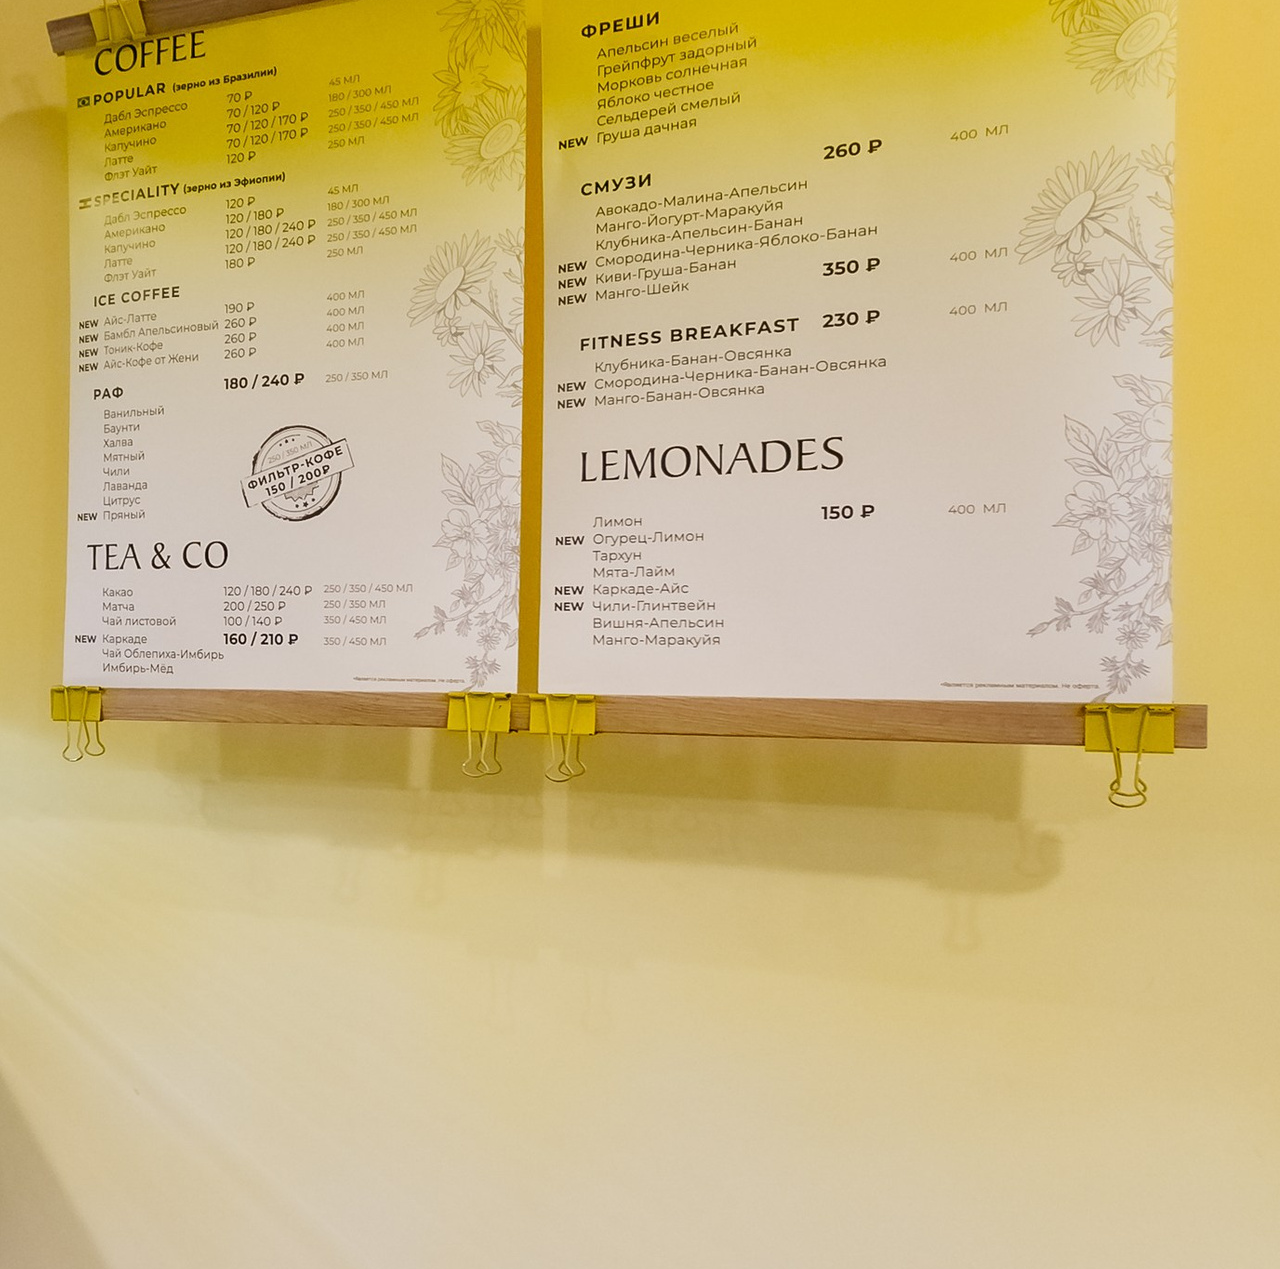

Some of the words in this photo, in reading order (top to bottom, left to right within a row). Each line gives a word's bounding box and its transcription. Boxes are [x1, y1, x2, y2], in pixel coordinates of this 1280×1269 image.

[581, 11, 659, 38] ФРЕШИ
[596, 37, 668, 60] Апельсин
[673, 21, 738, 44] веселый
[94, 30, 206, 76] COFFEE
[597, 52, 676, 78] Грейпфрут
[679, 36, 756, 60] задорный
[597, 74, 662, 93] Морковь
[665, 57, 747, 80] солнечная
[93, 82, 166, 106] POPULAR
[172, 80, 206, 93] (зерно
[208, 77, 220, 86] из
[223, 65, 277, 84] Бразилии)
[597, 92, 650, 110] Яблоко
[653, 80, 714, 98] честное
[103, 109, 131, 125] Дабл
[133, 102, 188, 118] Эспрессо
[596, 101, 676, 126] Сельдерей
[680, 91, 740, 112] смелый
[103, 120, 166, 138] Американо
[558, 135, 588, 150] NEW
[596, 127, 640, 145] Груша
[643, 118, 696, 137] дачная
[104, 136, 156, 152] Капучино
[823, 141, 860, 159] 260
[103, 154, 133, 167] Латте
[104, 169, 130, 181] Флэт
[131, 164, 157, 177] Уайт
[94, 183, 180, 207] SPECIALITY
[183, 182, 217, 194] (зерно
[219, 180, 231, 188] из
[234, 171, 285, 187] Эфиопии)
[580, 173, 651, 196] СМУЗИ
[595, 180, 807, 217] Авокадо-Малина-Апельсин
[596, 199, 783, 234] Манго-Йогурт-Маракуйя
[104, 223, 165, 239] Американо
[595, 216, 802, 251] Клубника-Апельсин-Банан
[104, 239, 156, 254] Капучино
[558, 260, 587, 274] NEW
[595, 225, 877, 267] Смородина-Черника-Яблоко-Банан
[103, 257, 132, 268] Латте
[822, 259, 859, 276] 350
[558, 276, 587, 289] NEW
[595, 259, 736, 284] Киви-Груша-Банан
[93, 293, 115, 307] ICE
[120, 285, 179, 303] COFFEE
[558, 292, 587, 306] NEW
[595, 280, 689, 301] Манго-Шейк
[224, 302, 243, 314] 190
[78, 319, 98, 329] NEW
[103, 312, 157, 326] Айс-Латте
[78, 333, 98, 344] NEW
[103, 327, 135, 341] Бамбл
[137, 319, 218, 337] Апельсиновый
[580, 330, 661, 351] FITNESS
[670, 317, 799, 342] BREAKFAST
[822, 311, 858, 328] 230
[78, 347, 98, 358] NEW
[103, 339, 163, 354] Тоник-Кофе
[78, 362, 98, 372] NEW
[103, 356, 152, 369] Айс-Кофе
[154, 356, 166, 364] от
[167, 352, 198, 364] Жени
[594, 347, 791, 374] Клубника-Банан-Овсянка
[223, 376, 248, 389] 180
[261, 373, 289, 387] 240
[557, 380, 586, 392] NEW
[594, 357, 886, 389] Смородина-Черника-Банан-Овсянка
[93, 386, 123, 400] РАФ
[557, 397, 586, 409] NEW
[594, 385, 764, 406] Манго-Банан-Овсянка
[103, 404, 164, 419] Ванильный
[103, 423, 140, 435] Баунти
[102, 438, 133, 448] Халва
[103, 450, 144, 462] Мятный
[580, 436, 843, 482] LEMONADES
[102, 467, 130, 476] Чили
[248, 446, 343, 489] ФИЛЬТР-КОФЕ
[102, 481, 147, 491] Лаванда
[266, 482, 286, 496] 150
[102, 496, 140, 507] Цитрус
[77, 512, 97, 521] NEW
[102, 508, 145, 522] Пряный
[820, 505, 853, 519] 150
[592, 516, 642, 528] Лимон
[555, 535, 584, 545] NEW
[592, 531, 704, 546] Огурец-Лимон
[86, 543, 141, 570] TEA
[151, 542, 170, 569] &
[182, 540, 228, 568] CO
[592, 550, 641, 563] Тархун
[592, 565, 674, 578] Мята-Лайм
[102, 587, 133, 597] Какао
[554, 585, 584, 595] NEW
[592, 582, 688, 597] Каркаде-Айс
[102, 601, 134, 611] Матча
[554, 601, 584, 611] NEW
[592, 599, 715, 611] Чили-Глинтвейн
[101, 615, 122, 625] Чай
[124, 615, 176, 626] листовой
[592, 617, 724, 628] Вишня-Апельсин
[74, 634, 96, 643] NEW
[102, 633, 147, 645] Каркаде
[223, 632, 247, 645] 160
[260, 633, 283, 645] 210
[592, 634, 720, 648] Манго-Маракуйя
[102, 648, 121, 658] Чай
[123, 647, 224, 661] Облепиха-Имбирь
[102, 661, 174, 674] Имбирь-Мёд
